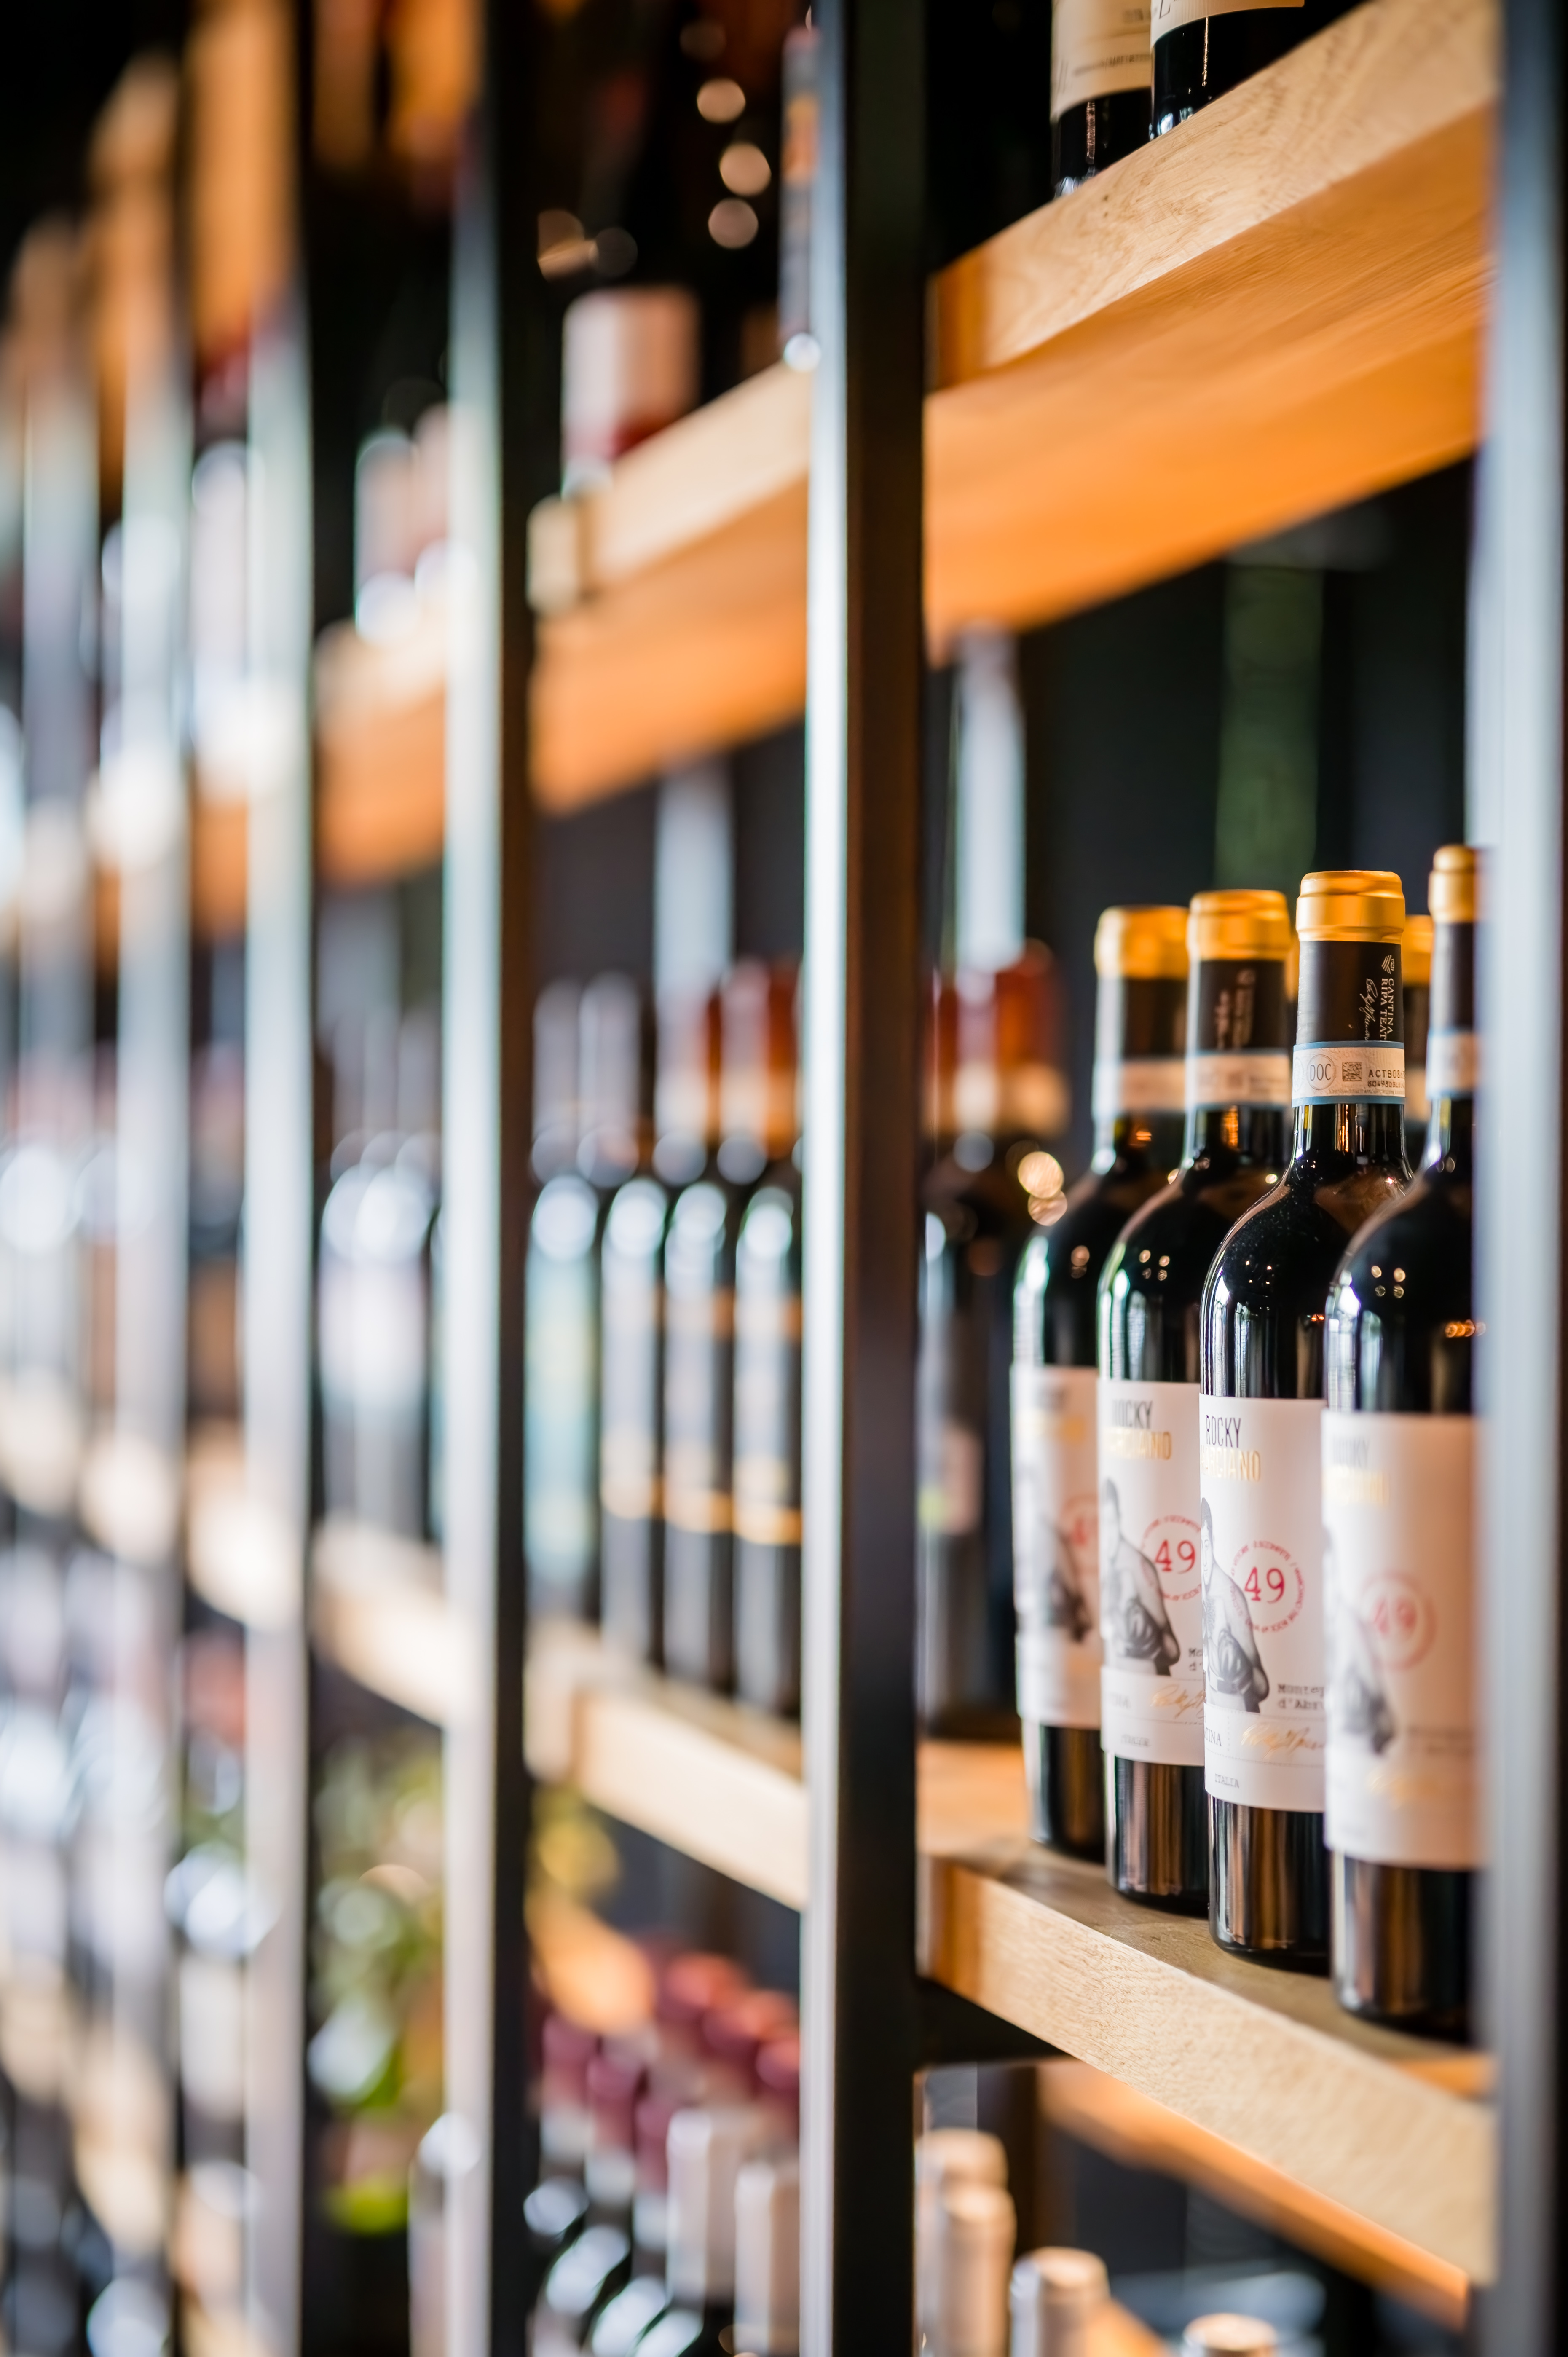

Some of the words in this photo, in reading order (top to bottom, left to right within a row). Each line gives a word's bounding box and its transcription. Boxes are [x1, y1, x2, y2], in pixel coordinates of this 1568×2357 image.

[1310, 1064, 1331, 1081] DOC
[1206, 1415, 1241, 1448] ROCKY
[1155, 1539, 1195, 1574] 49
[1244, 1566, 1285, 1604] 49
[1215, 1773, 1240, 1788] ITALIA
